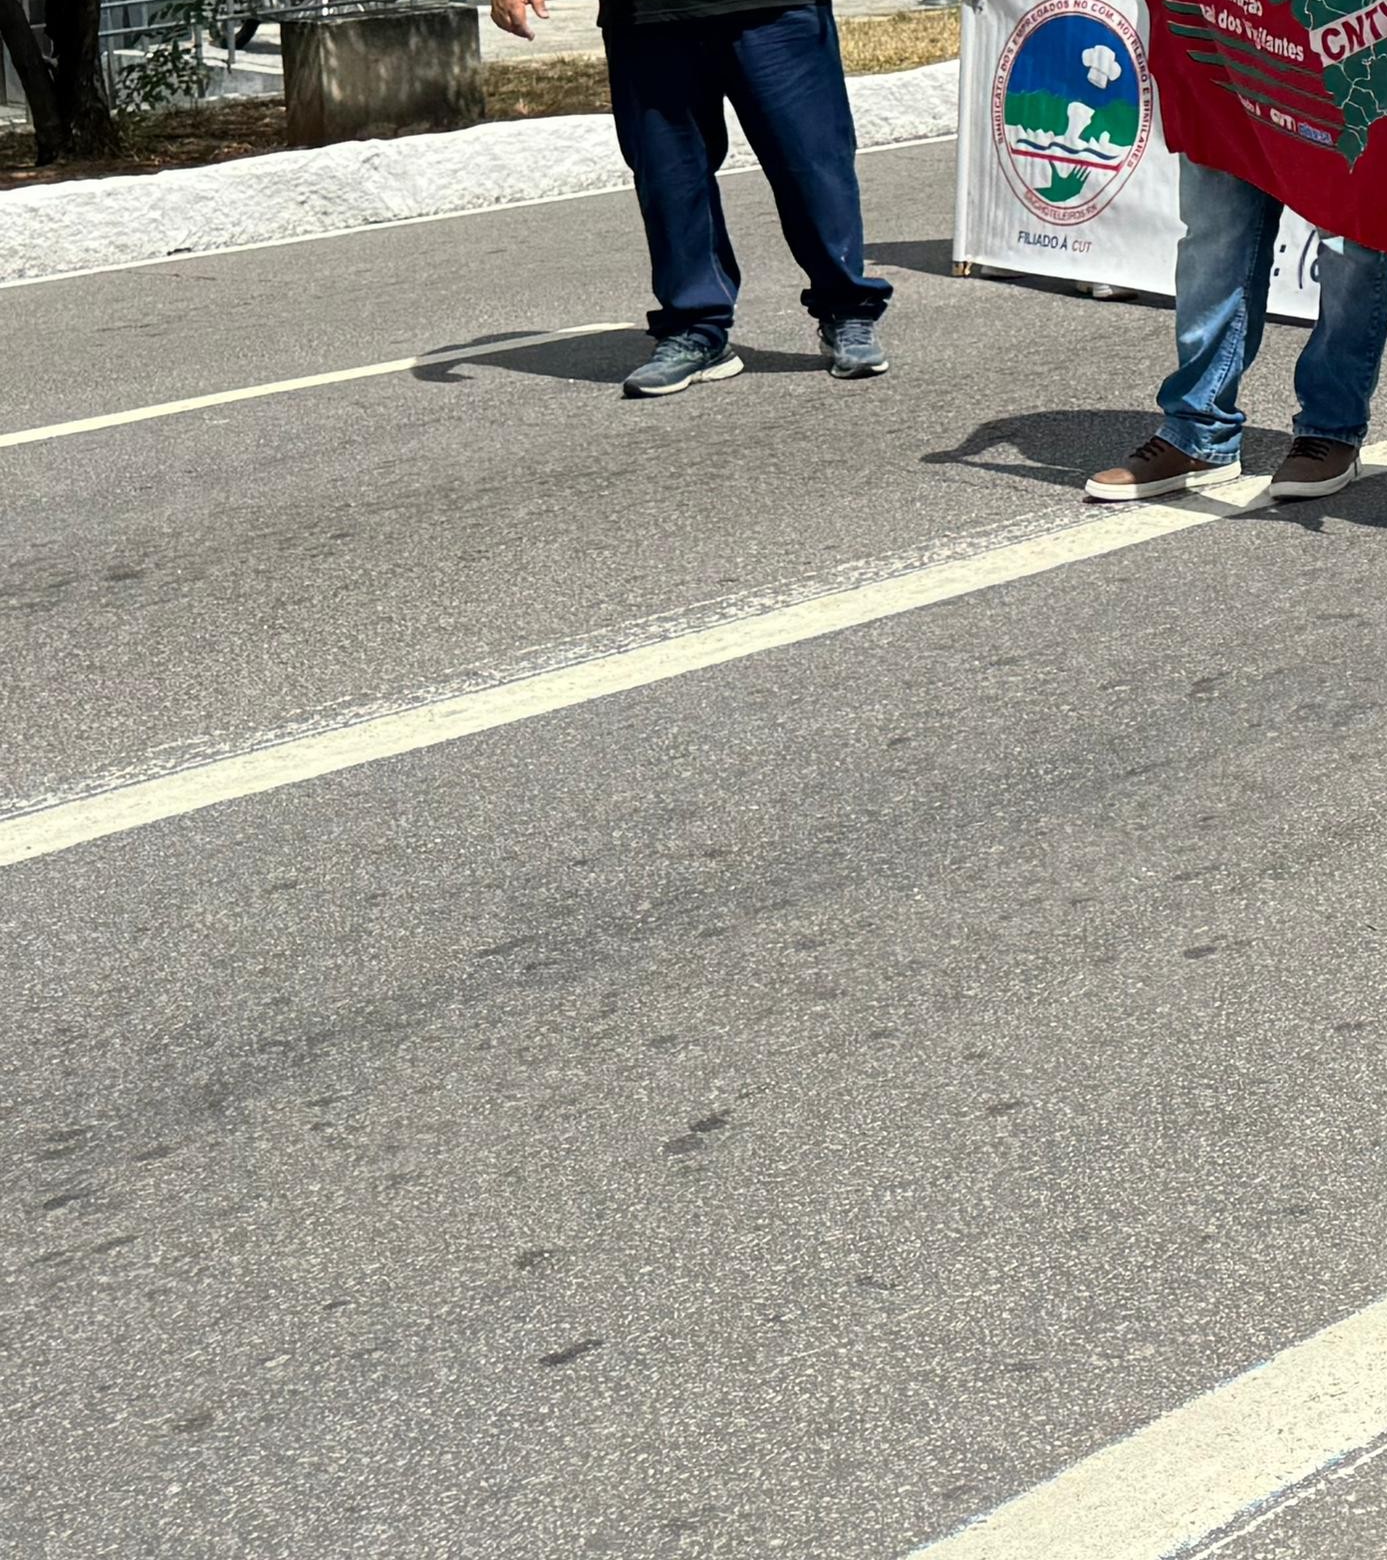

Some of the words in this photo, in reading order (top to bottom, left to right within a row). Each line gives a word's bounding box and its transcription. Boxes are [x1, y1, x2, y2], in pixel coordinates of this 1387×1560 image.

[1073, 0, 1088, 10] NO
[1217, 8, 1244, 35] dos
[1017, 230, 1058, 250] FILIADO
[1072, 239, 1092, 253] CUT
